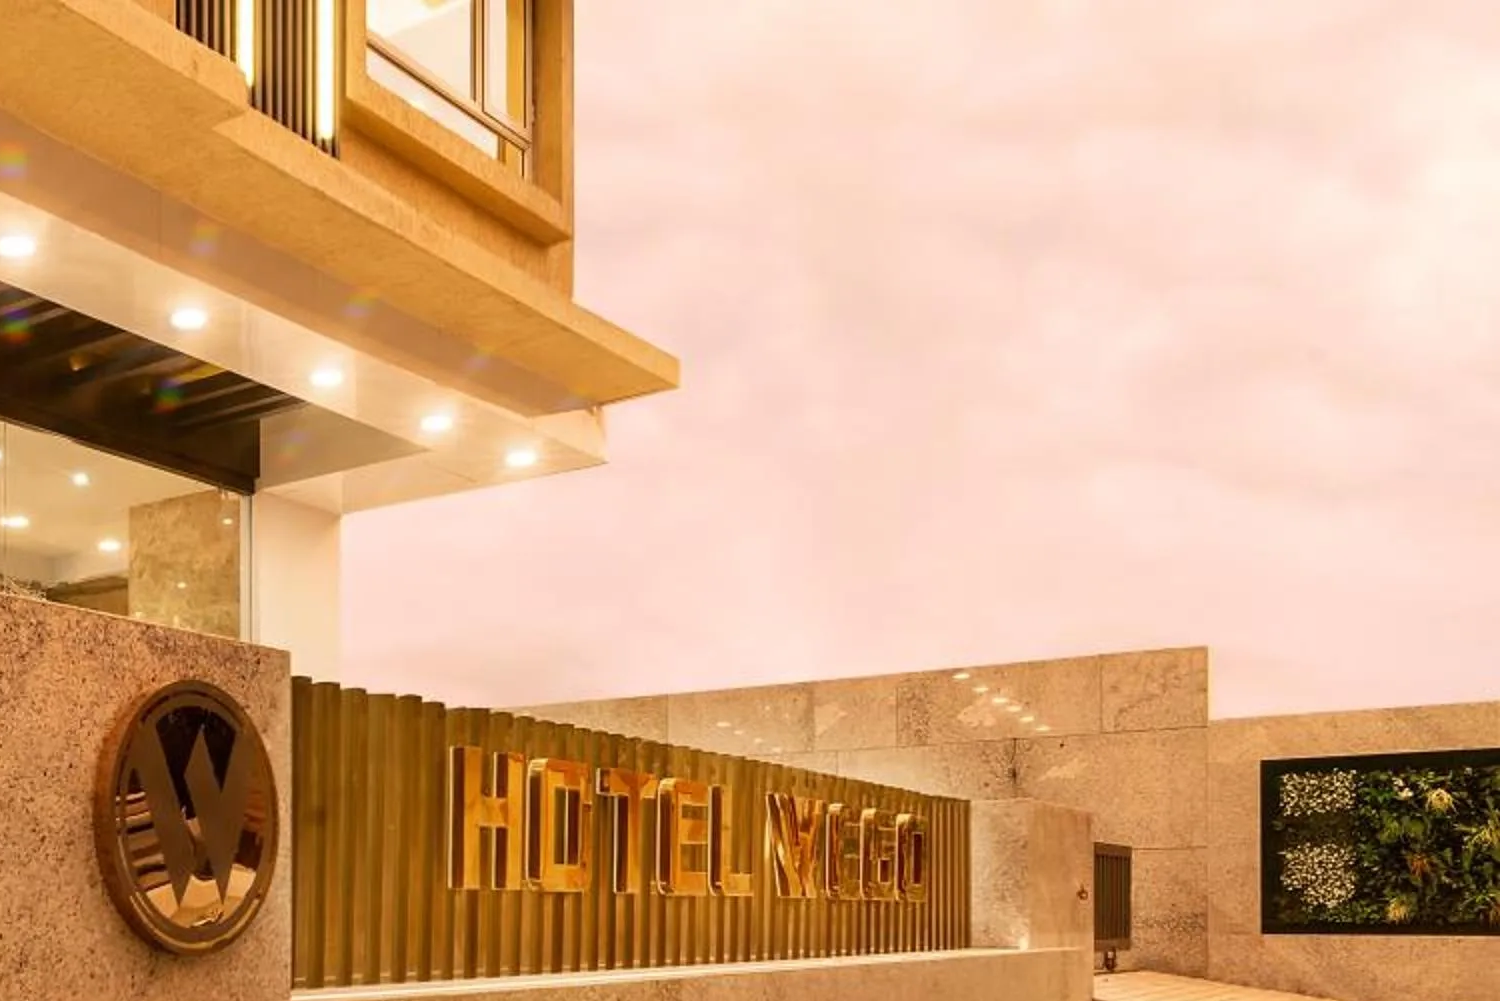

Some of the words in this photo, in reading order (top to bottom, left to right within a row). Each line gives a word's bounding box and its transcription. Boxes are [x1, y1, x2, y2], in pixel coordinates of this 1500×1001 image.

[128, 707, 258, 907] W
[448, 745, 755, 896] HOTEL
[764, 791, 930, 902] WEGO
